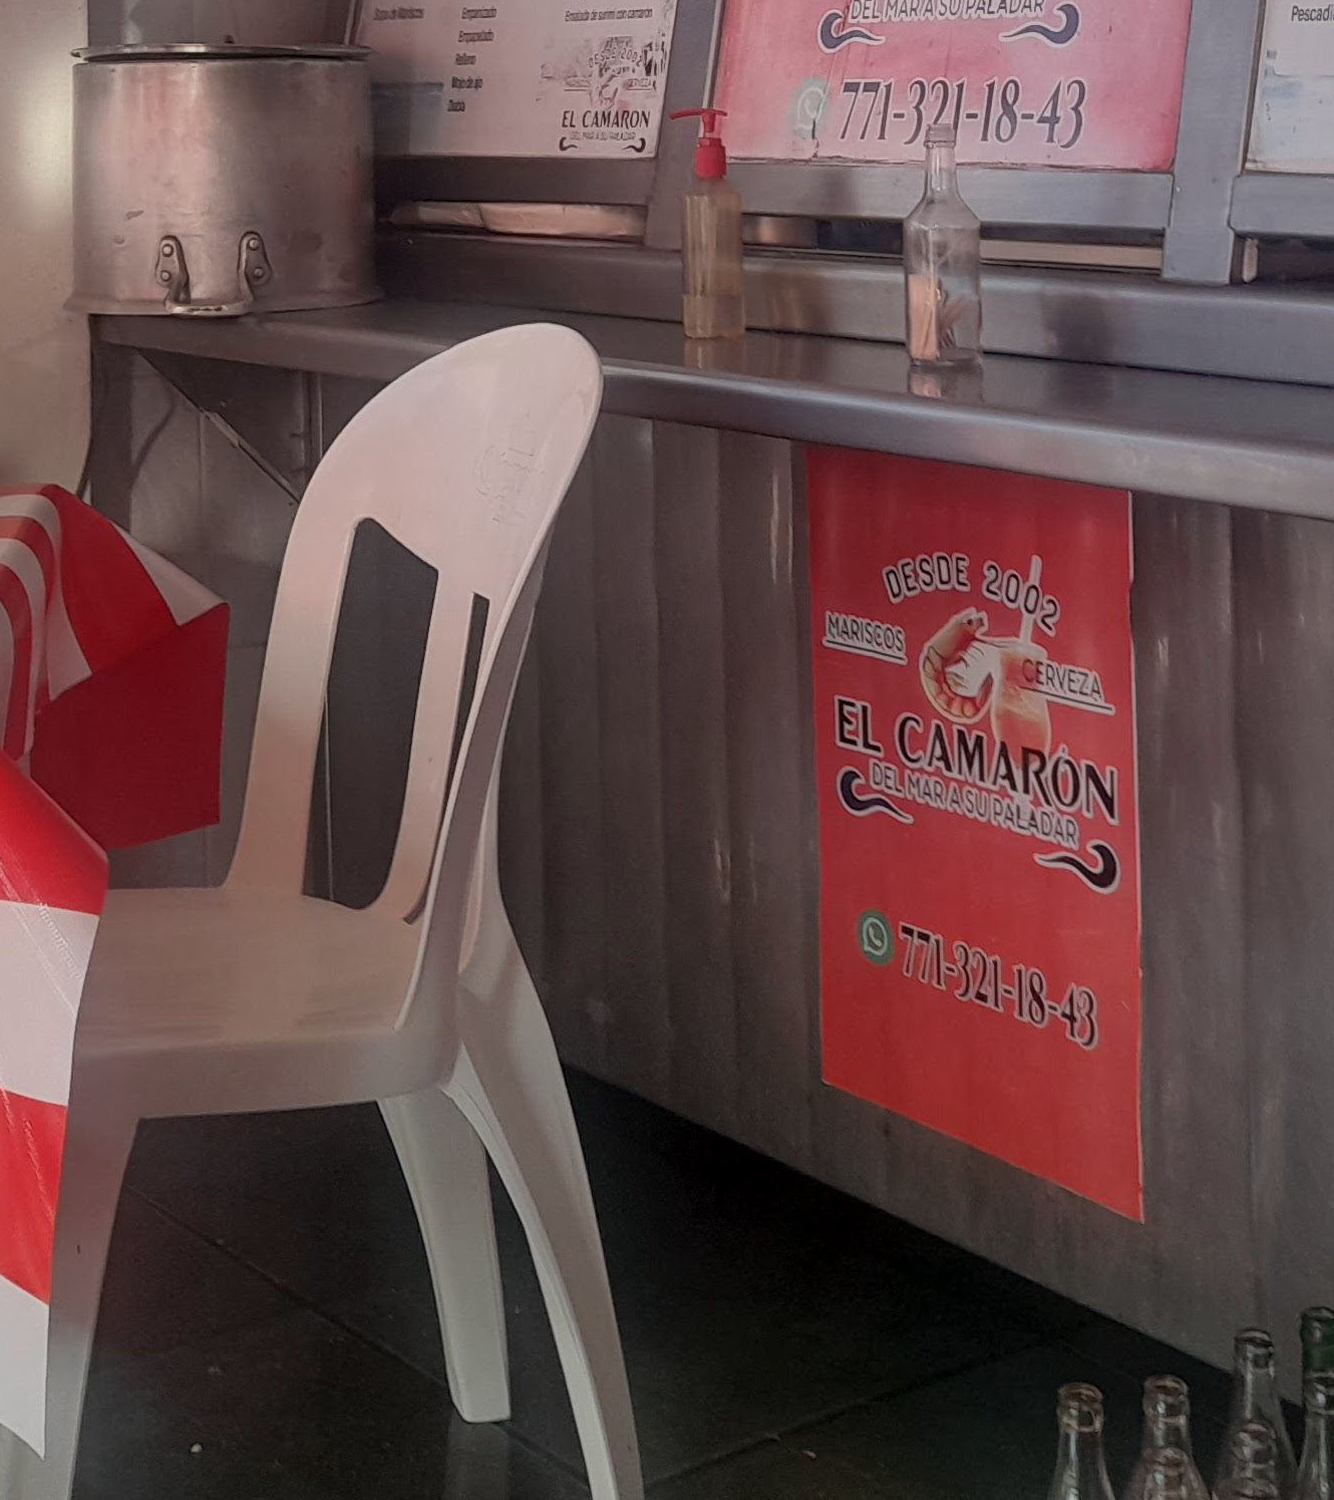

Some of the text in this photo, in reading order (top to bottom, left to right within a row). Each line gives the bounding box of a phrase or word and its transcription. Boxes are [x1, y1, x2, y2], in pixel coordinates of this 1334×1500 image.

[561, 109, 651, 130] EL CAMARON
[838, 77, 1088, 149] 771-321-18-43
[884, 553, 1059, 633] DESDE 2002
[826, 611, 1103, 701] MARISCOS CERVEZA
[837, 698, 1117, 823] EL CAMARÓN
[870, 761, 1078, 846] DEL MAR A SU PALADAR
[900, 923, 1098, 1049] 771-321-18-43
